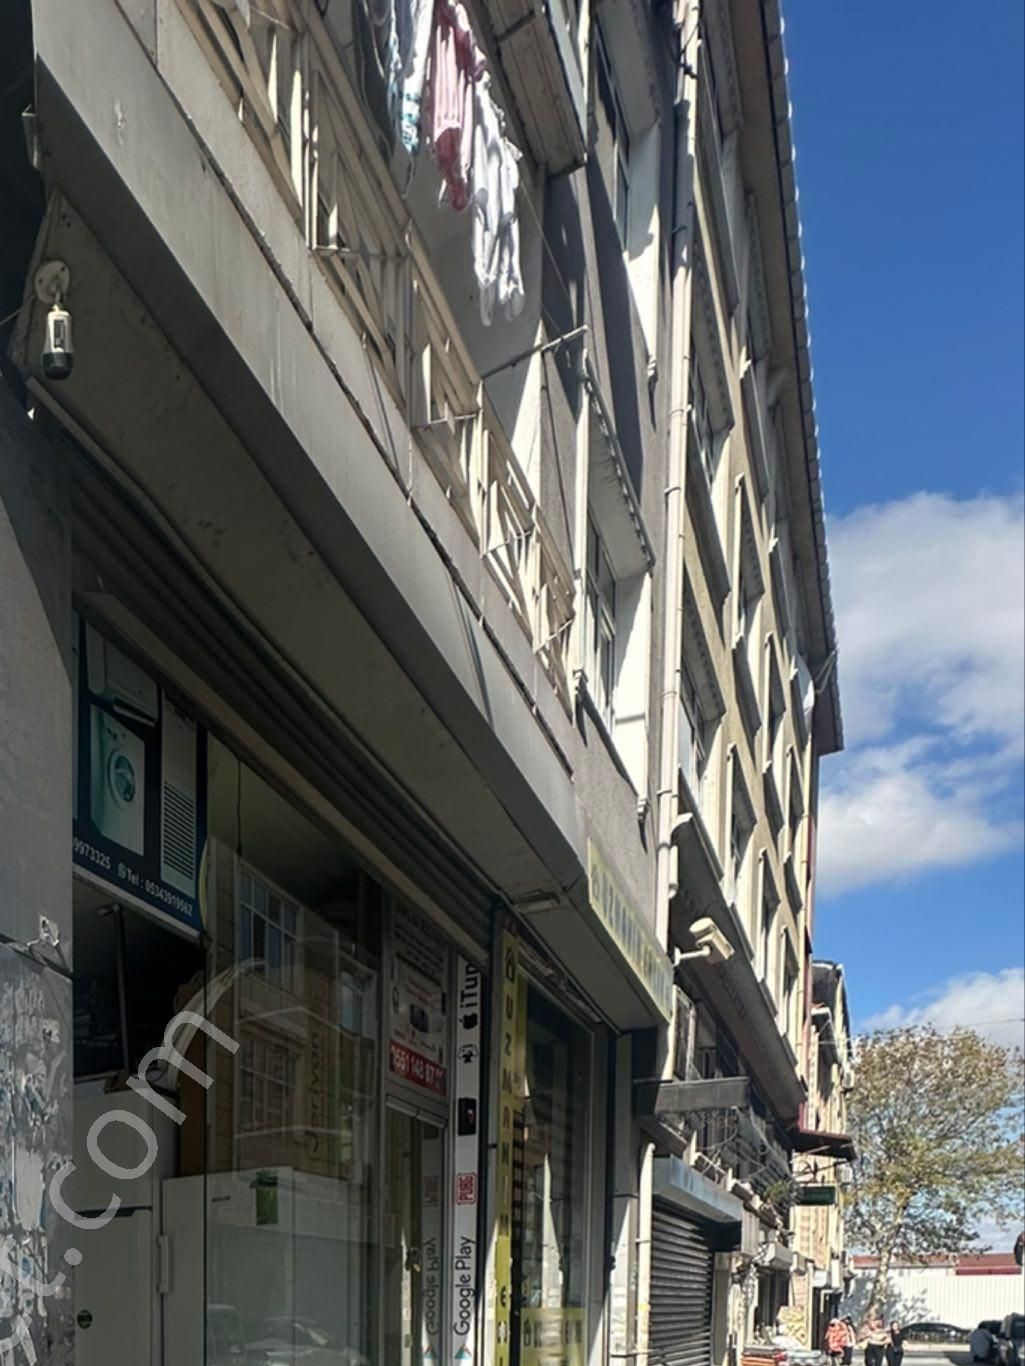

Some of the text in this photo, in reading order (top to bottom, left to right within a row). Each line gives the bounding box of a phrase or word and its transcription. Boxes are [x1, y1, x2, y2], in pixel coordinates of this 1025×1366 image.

[459, 1174, 474, 1201] PUBG
[454, 1236, 476, 1336] Google Play
